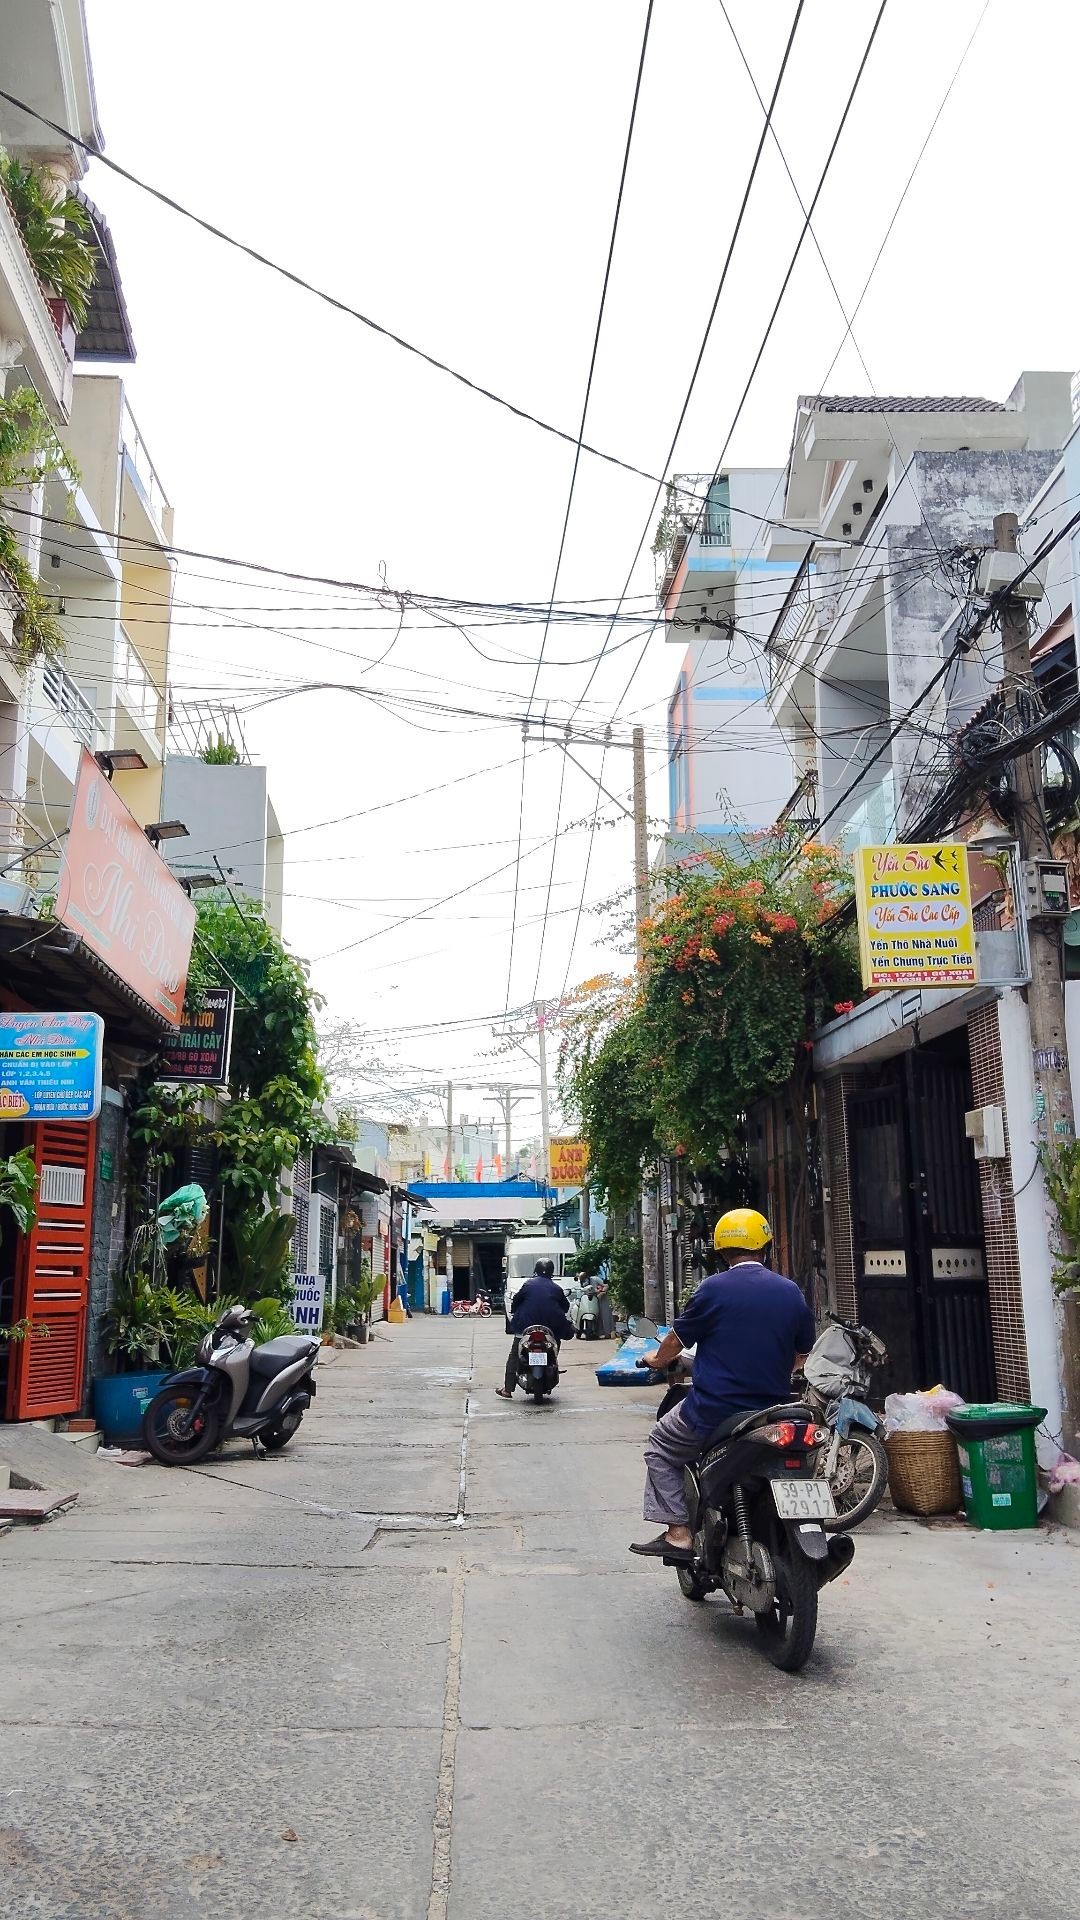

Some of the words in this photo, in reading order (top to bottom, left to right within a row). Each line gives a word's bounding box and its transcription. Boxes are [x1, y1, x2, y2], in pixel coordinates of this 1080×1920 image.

[872, 852, 898, 880] Yến
[870, 881, 918, 898] PHƯỚC
[922, 883, 960, 896] SANG
[874, 906, 895, 929] Yến
[941, 904, 960, 925] Cấp
[870, 938, 888, 950] Yến
[912, 938, 932, 949] Nhà
[934, 938, 958, 948] Nuôi
[872, 956, 890, 968] Yến
[892, 956, 924, 968] Chưng
[951, 952, 973, 966] Tiếp
[180, 1030, 201, 1048] TRÁI
[203, 1031, 222, 1049] CÂY
[44, 1050, 58, 1058] HỌC
[781, 1482, 821, 1498] 59-P1
